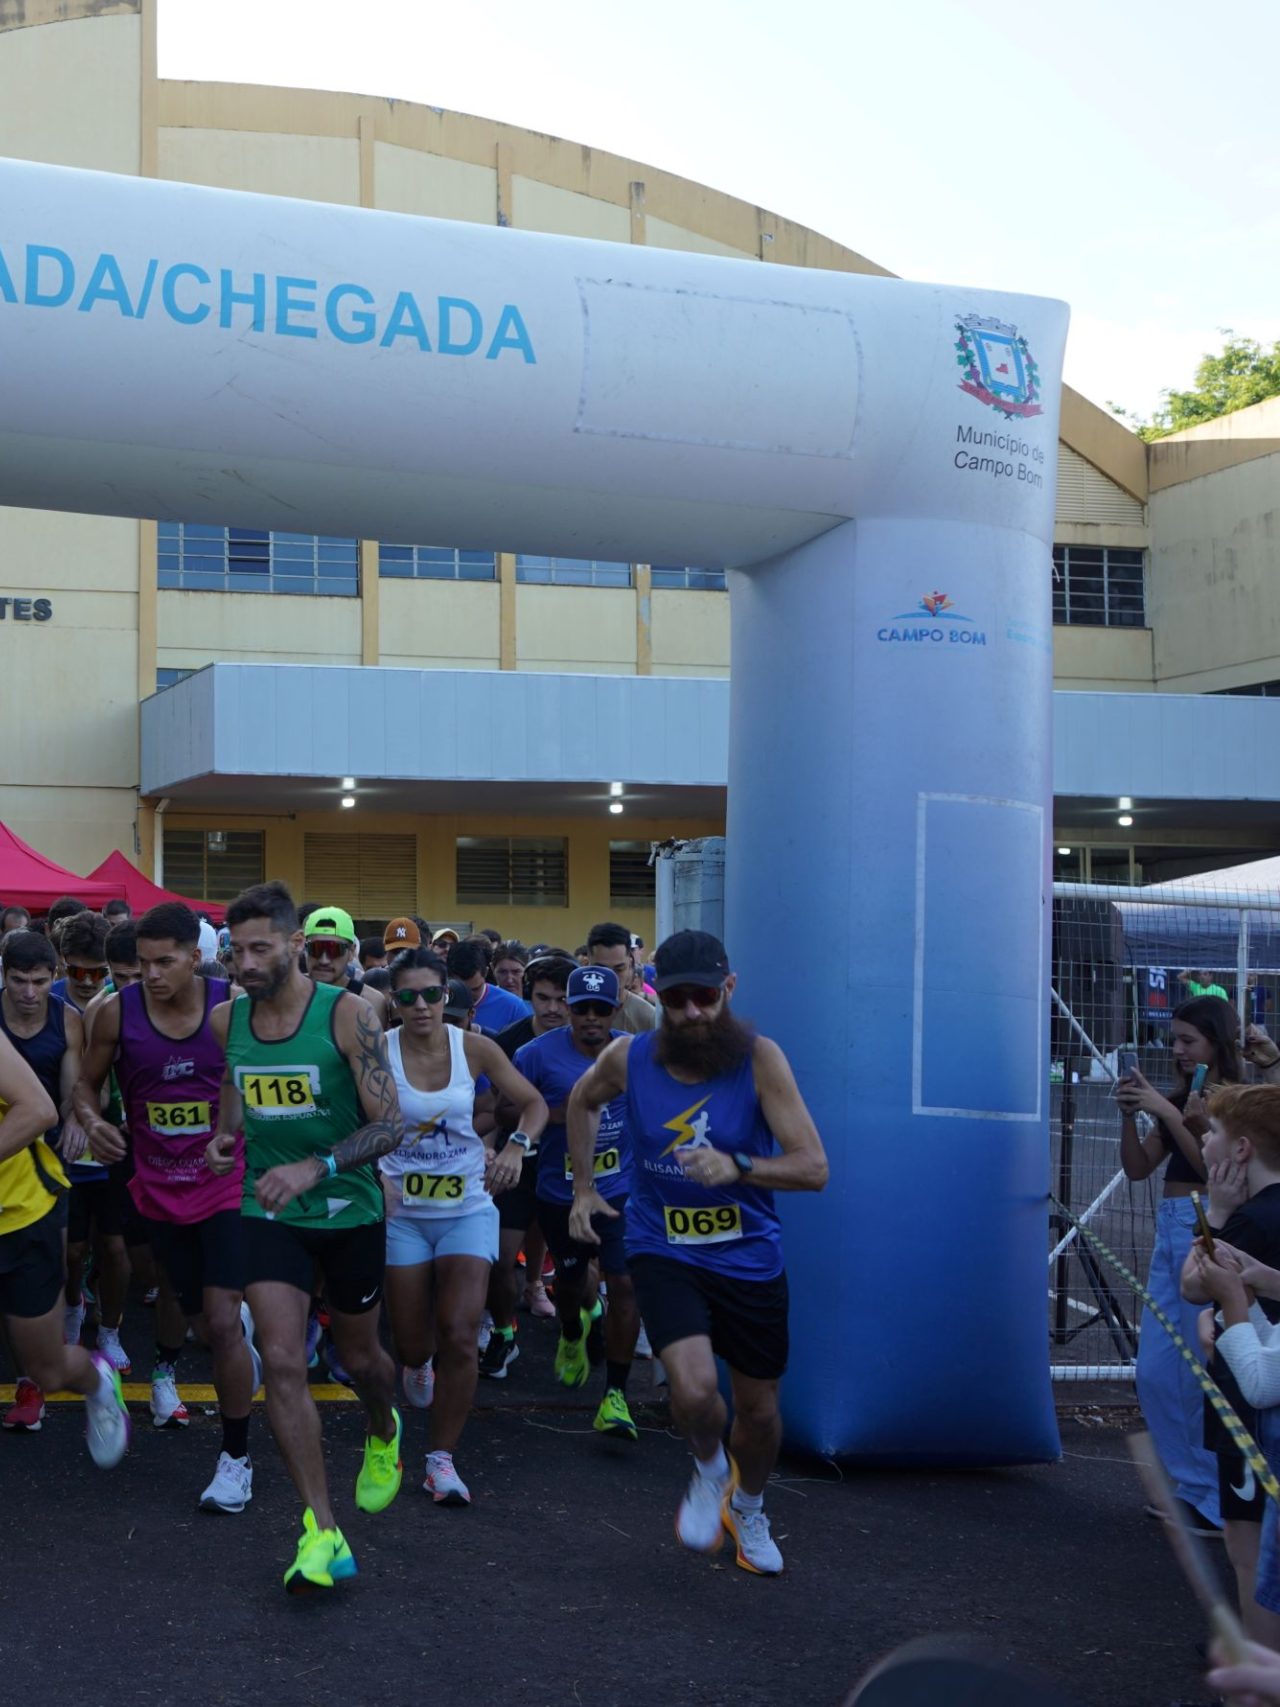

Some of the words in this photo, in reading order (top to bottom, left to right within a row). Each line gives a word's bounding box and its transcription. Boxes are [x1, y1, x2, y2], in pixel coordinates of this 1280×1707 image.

[956, 425, 1029, 456] Município
[1032, 446, 1044, 464] de
[954, 450, 1014, 478] Campo
[1017, 462, 1043, 488] Bom
[877, 628, 944, 643] CAMPO
[949, 630, 986, 646] BOM
[249, 1078, 307, 1105] 118
[153, 1106, 205, 1127] 361
[406, 1173, 463, 1198] 073
[669, 1207, 737, 1235] 069
